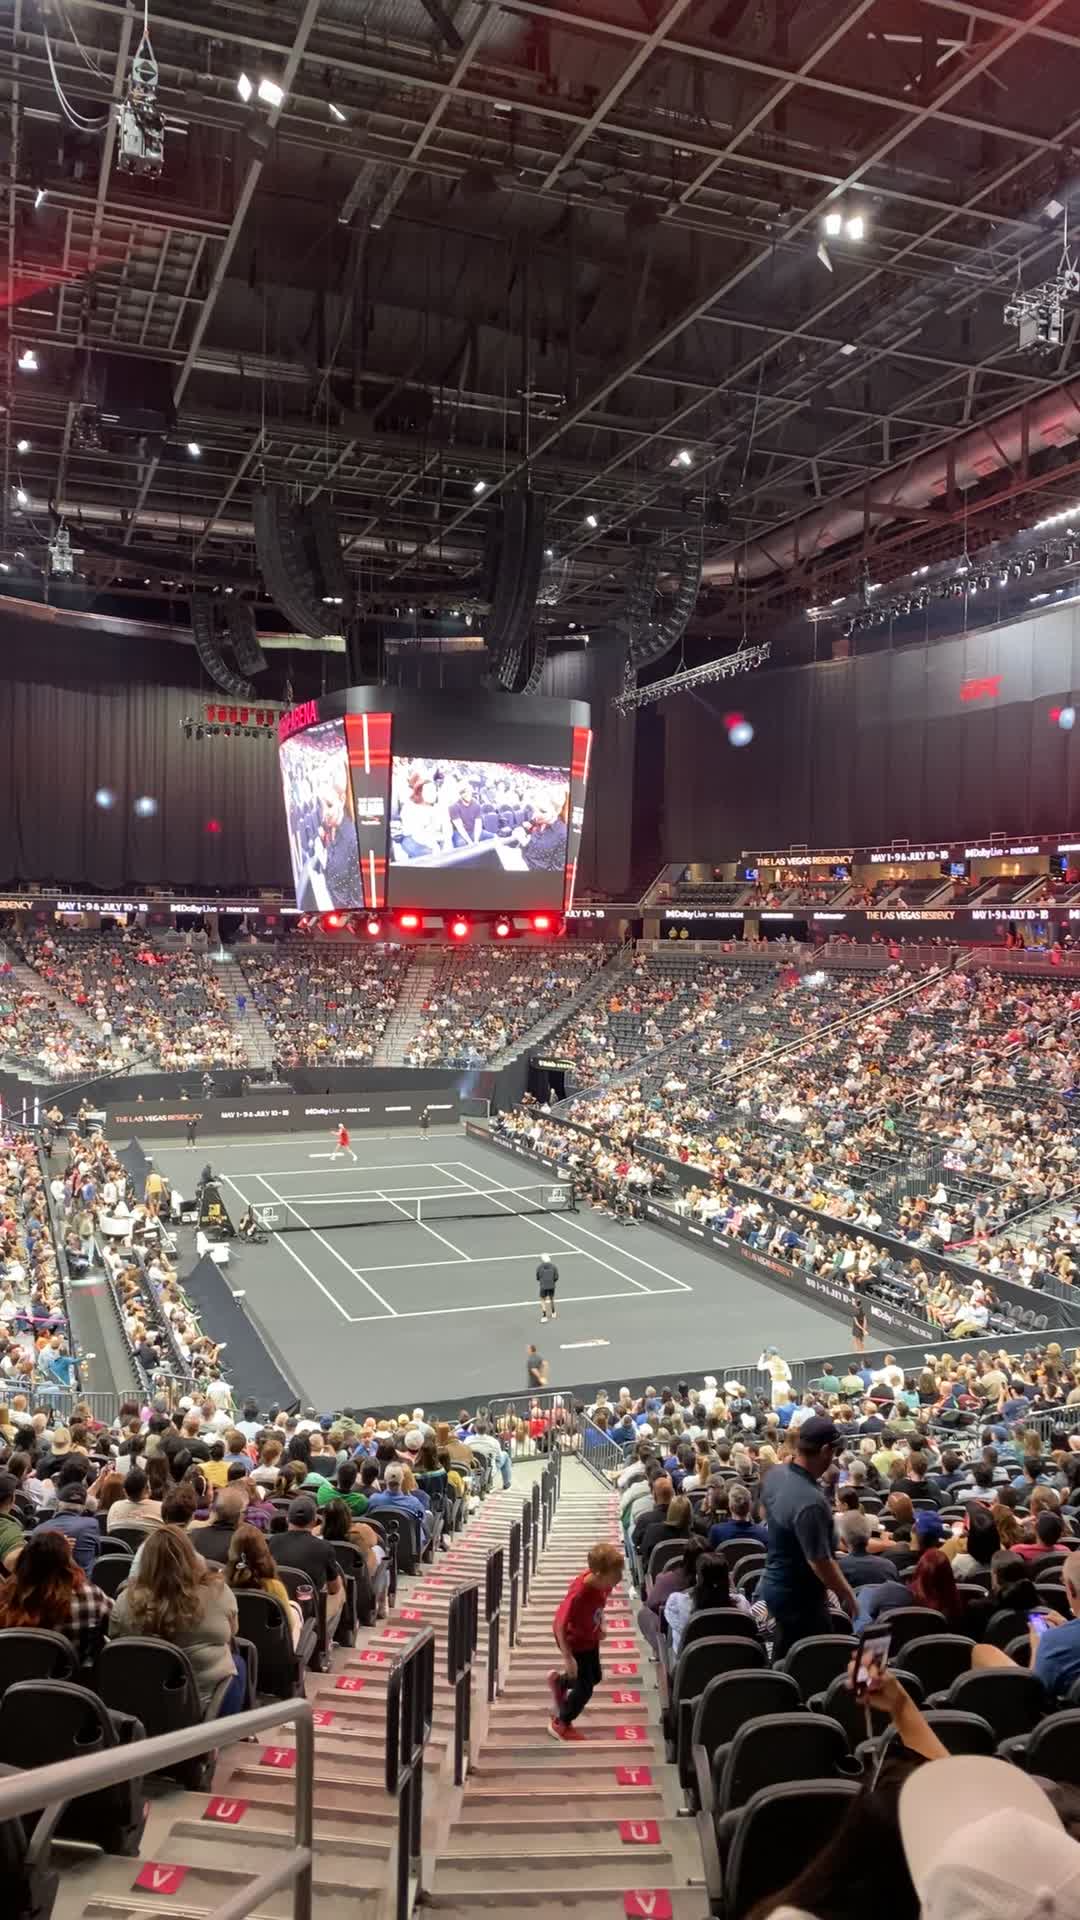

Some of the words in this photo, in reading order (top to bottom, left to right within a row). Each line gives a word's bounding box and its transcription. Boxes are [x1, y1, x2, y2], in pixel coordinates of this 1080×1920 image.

[756, 858, 771, 866] THE
[771, 857, 786, 866] LAS
[787, 856, 812, 865] VEGAS
[812, 855, 853, 865] RESIDENCY
[871, 853, 886, 862] MAY
[907, 852, 926, 861] JULY
[57, 902, 76, 911] MAY
[100, 903, 122, 912] JULY
[866, 911, 880, 920] THE
[880, 911, 895, 920] LAS
[896, 911, 920, 920] VEGAS
[920, 911, 955, 920] RESIDENCY
[972, 910, 988, 919] MAY
[1007, 910, 1027, 919] JULY
[114, 1115, 128, 1123] THE
[144, 1114, 167, 1122] VEGAS
[343, 1680, 356, 1689] R
[620, 1693, 633, 1702] R
[312, 1713, 324, 1724] S
[624, 1729, 638, 1739] S
[274, 1751, 288, 1764] T
[625, 1770, 640, 1783] T
[216, 1802, 236, 1818] U
[631, 1825, 648, 1840] U
[153, 1870, 174, 1888] V
[635, 1895, 656, 1914] V
